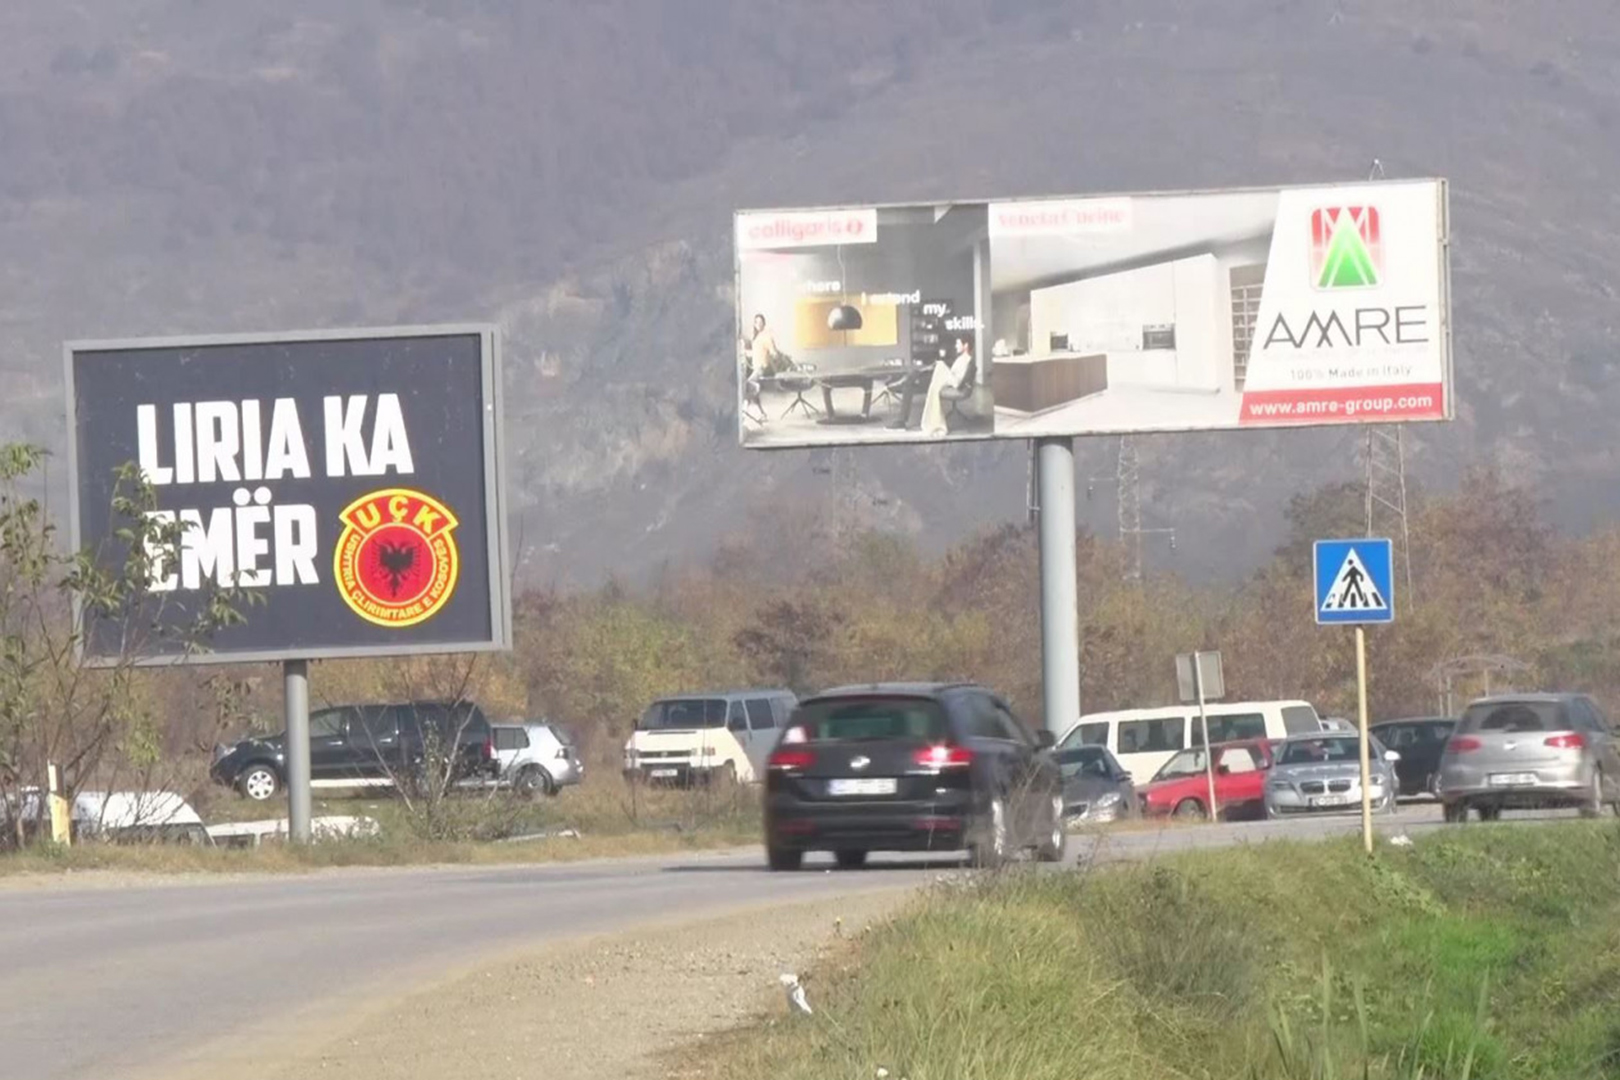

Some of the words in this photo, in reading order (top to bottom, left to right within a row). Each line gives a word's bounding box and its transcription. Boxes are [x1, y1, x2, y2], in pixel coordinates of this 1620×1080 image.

[870, 290, 921, 305] tend
[1263, 305, 1430, 350] AMRE
[1328, 366, 1363, 379] Made
[1367, 365, 1379, 376] in
[1383, 363, 1412, 377] Italy
[1249, 395, 1433, 415] www.amre-group.com
[137, 398, 311, 485] LIRIA
[323, 393, 415, 477] KA
[355, 495, 442, 534] UÇK
[143, 486, 320, 592] EMËR
